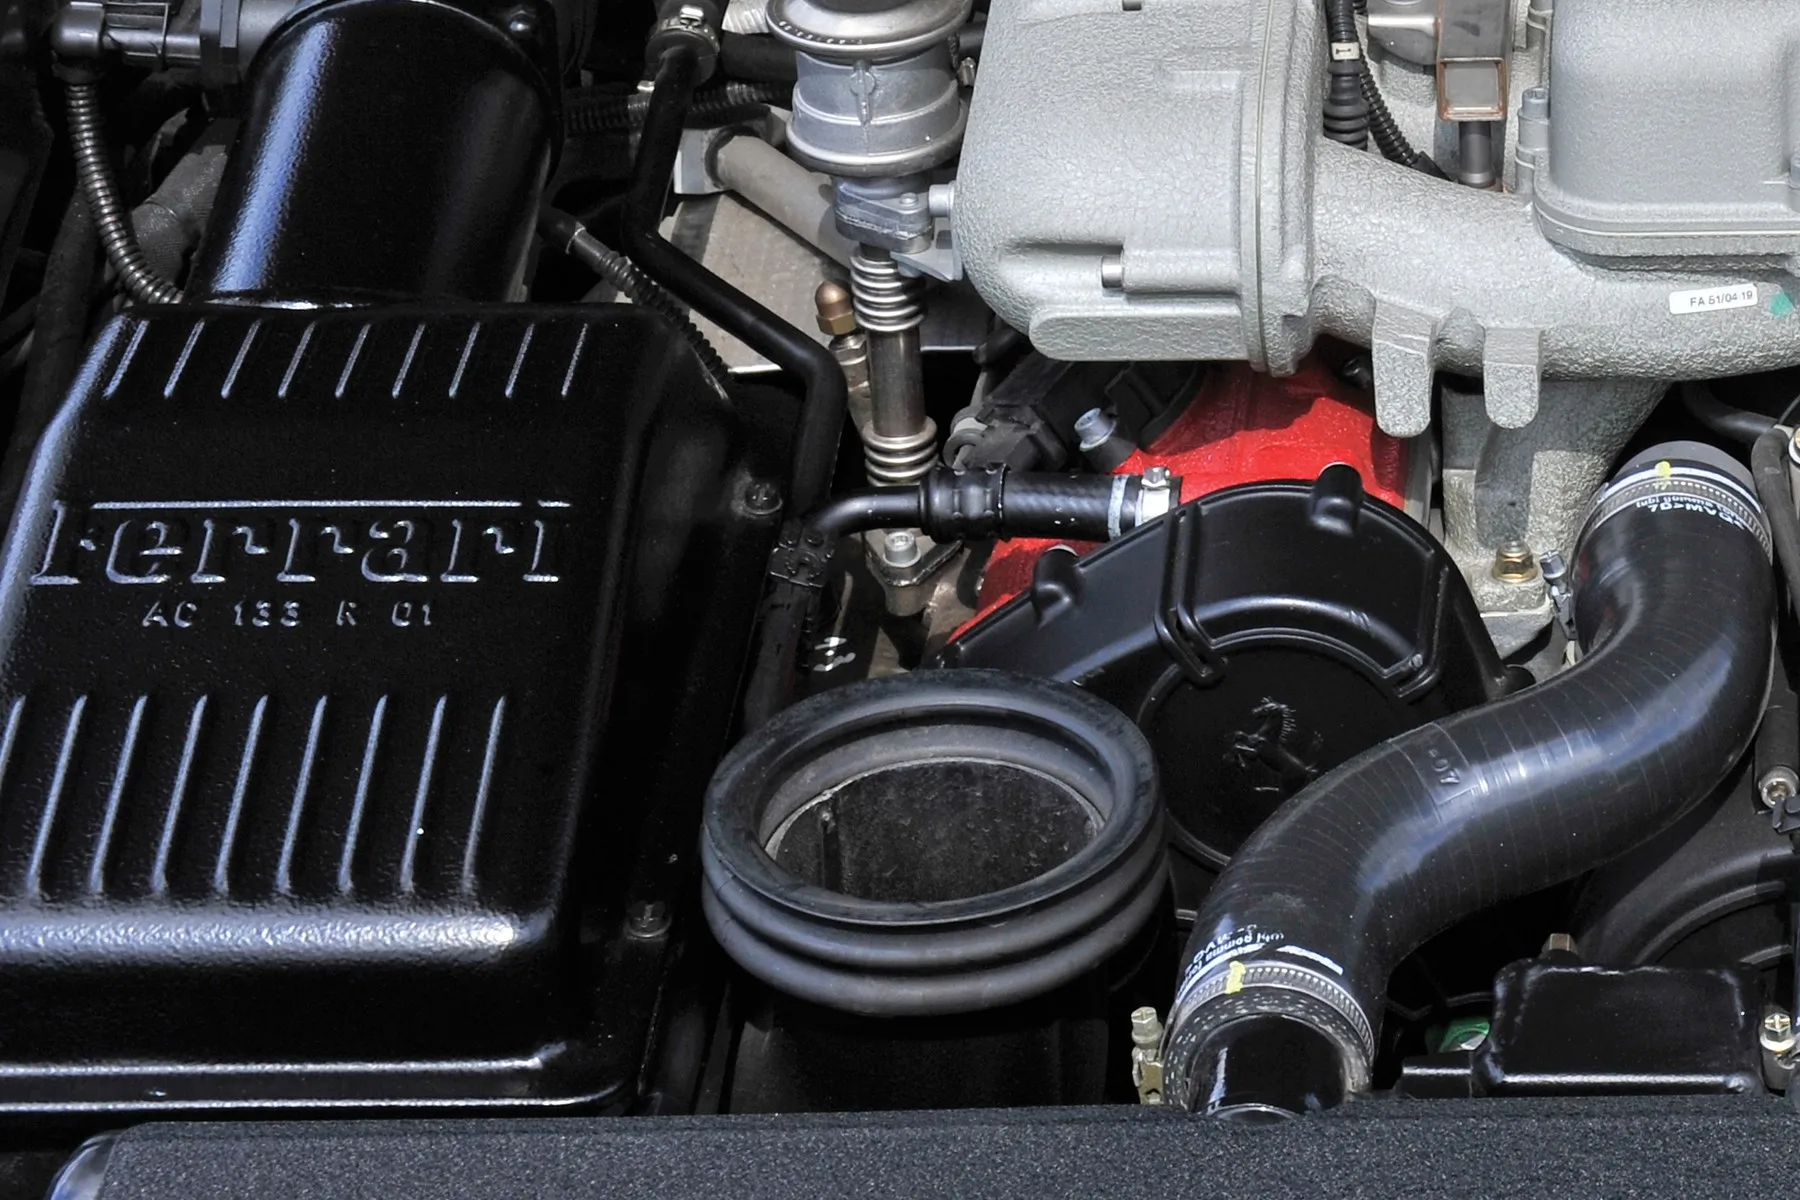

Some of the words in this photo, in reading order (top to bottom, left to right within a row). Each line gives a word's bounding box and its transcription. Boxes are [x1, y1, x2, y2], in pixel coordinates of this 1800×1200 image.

[32, 499, 572, 586] Ferrari
[142, 599, 197, 628] AC
[335, 599, 357, 627] R
[391, 599, 432, 628] 01
